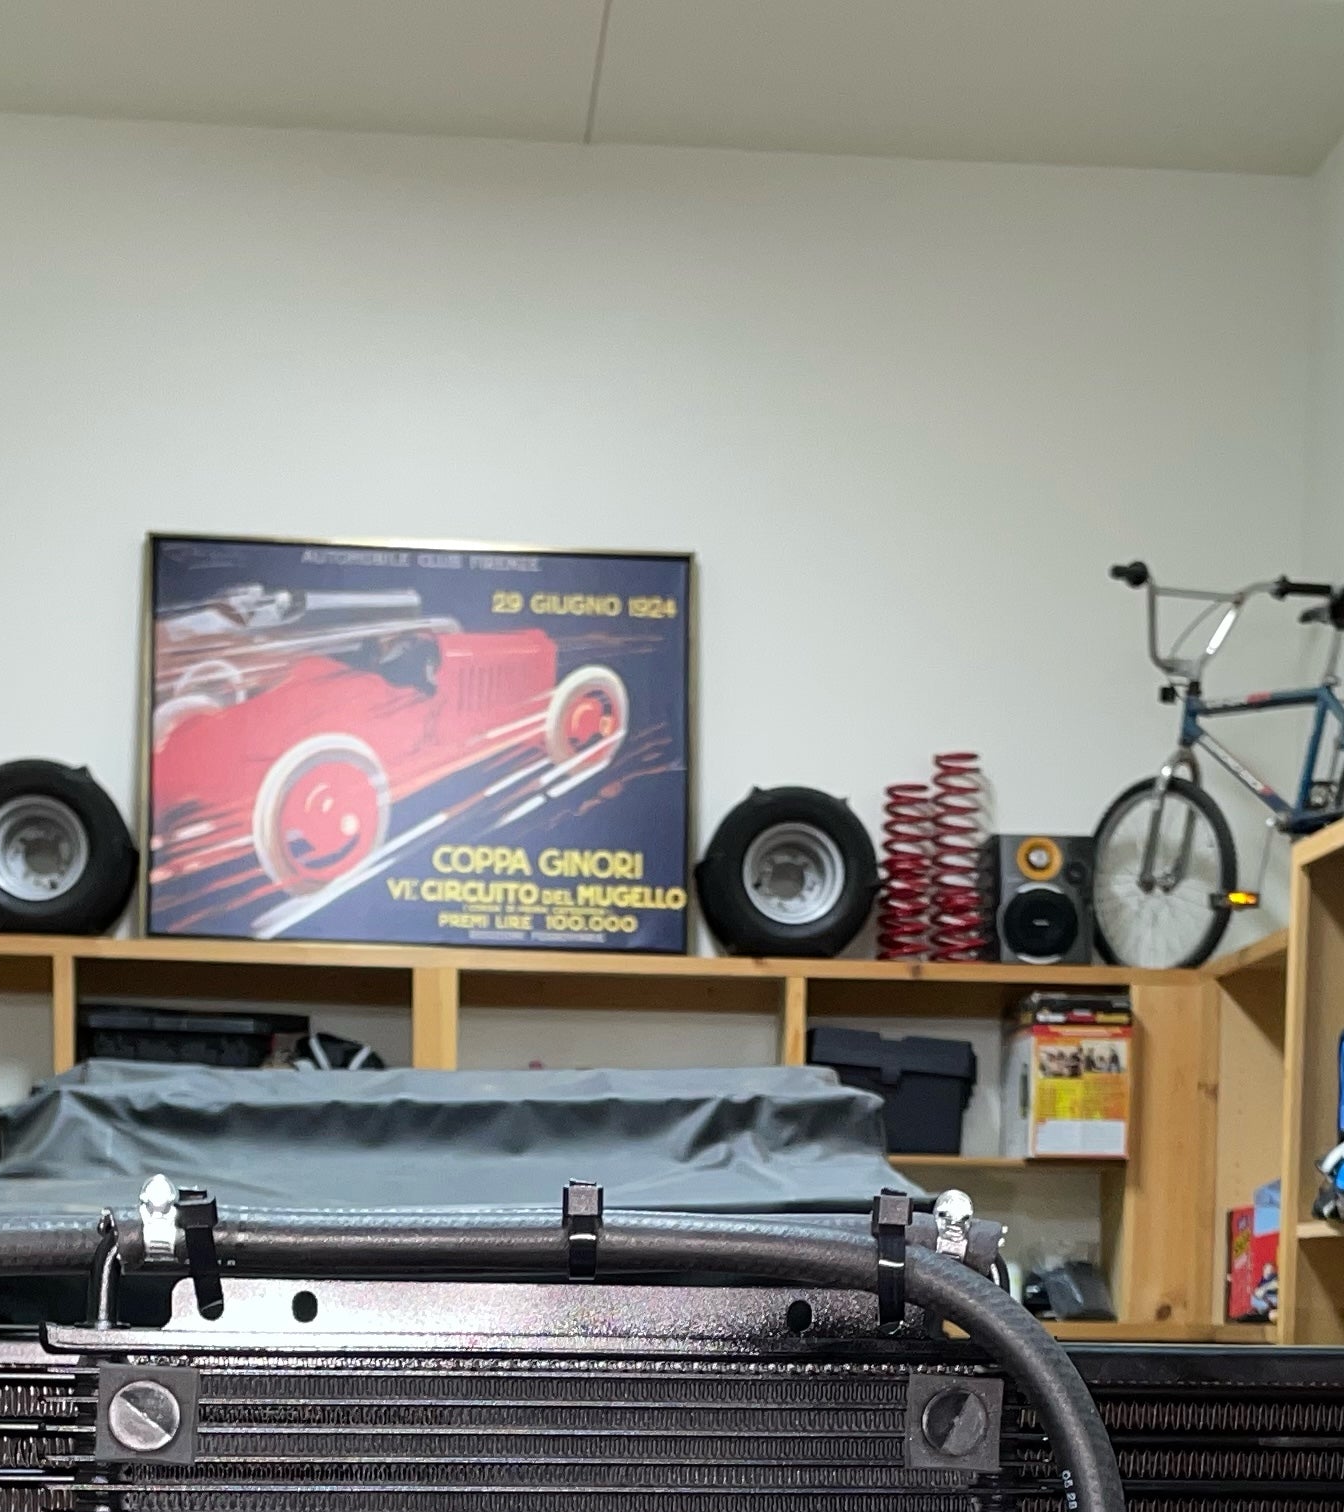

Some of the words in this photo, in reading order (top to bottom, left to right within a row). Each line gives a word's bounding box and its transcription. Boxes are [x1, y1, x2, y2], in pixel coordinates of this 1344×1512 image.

[491, 590, 523, 613] 29
[530, 592, 622, 616] GIUGNO
[432, 845, 532, 877] COPPA
[538, 848, 644, 880] GINORI
[420, 878, 538, 905] CIRCUITO
[577, 883, 687, 910] MUGELLO
[437, 911, 488, 929] PREMI
[495, 914, 533, 930] LIRE
